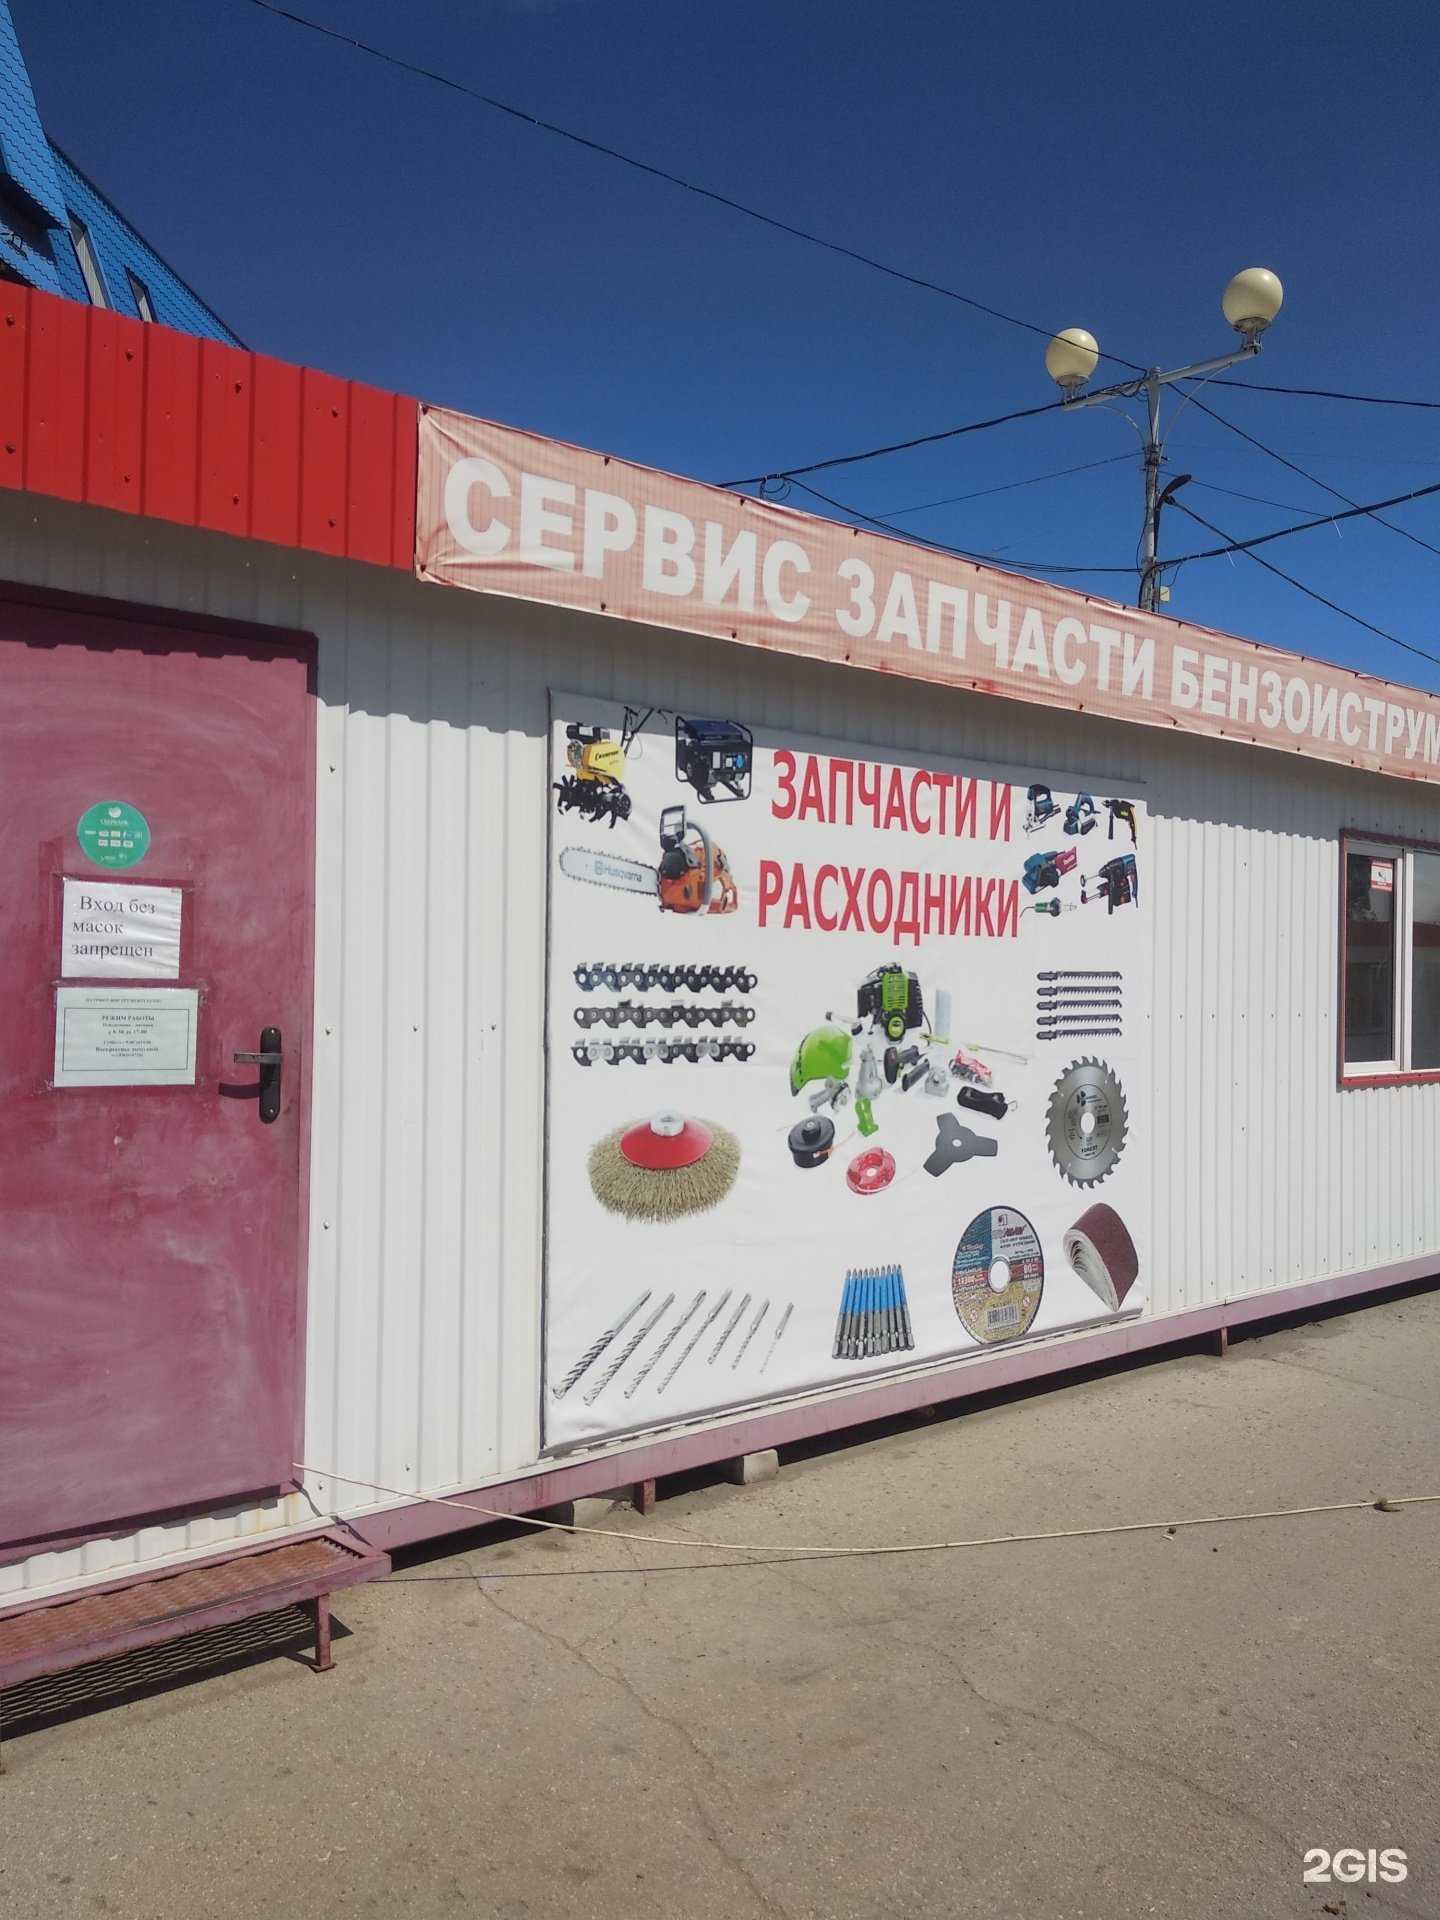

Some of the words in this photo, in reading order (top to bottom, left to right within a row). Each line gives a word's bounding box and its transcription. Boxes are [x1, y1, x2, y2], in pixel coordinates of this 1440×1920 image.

[444, 456, 812, 623] СЕРВИС
[835, 557, 1155, 700] ЗАПЧАСТИ
[771, 750, 977, 839] ЗАПЧАСТИ
[989, 780, 1012, 842] И
[72, 921, 124, 934] масок
[80, 896, 124, 913] Вход
[129, 899, 155, 914] без
[758, 859, 1019, 946] РАСХОДНИКИ
[71, 943, 153, 959] запрещен
